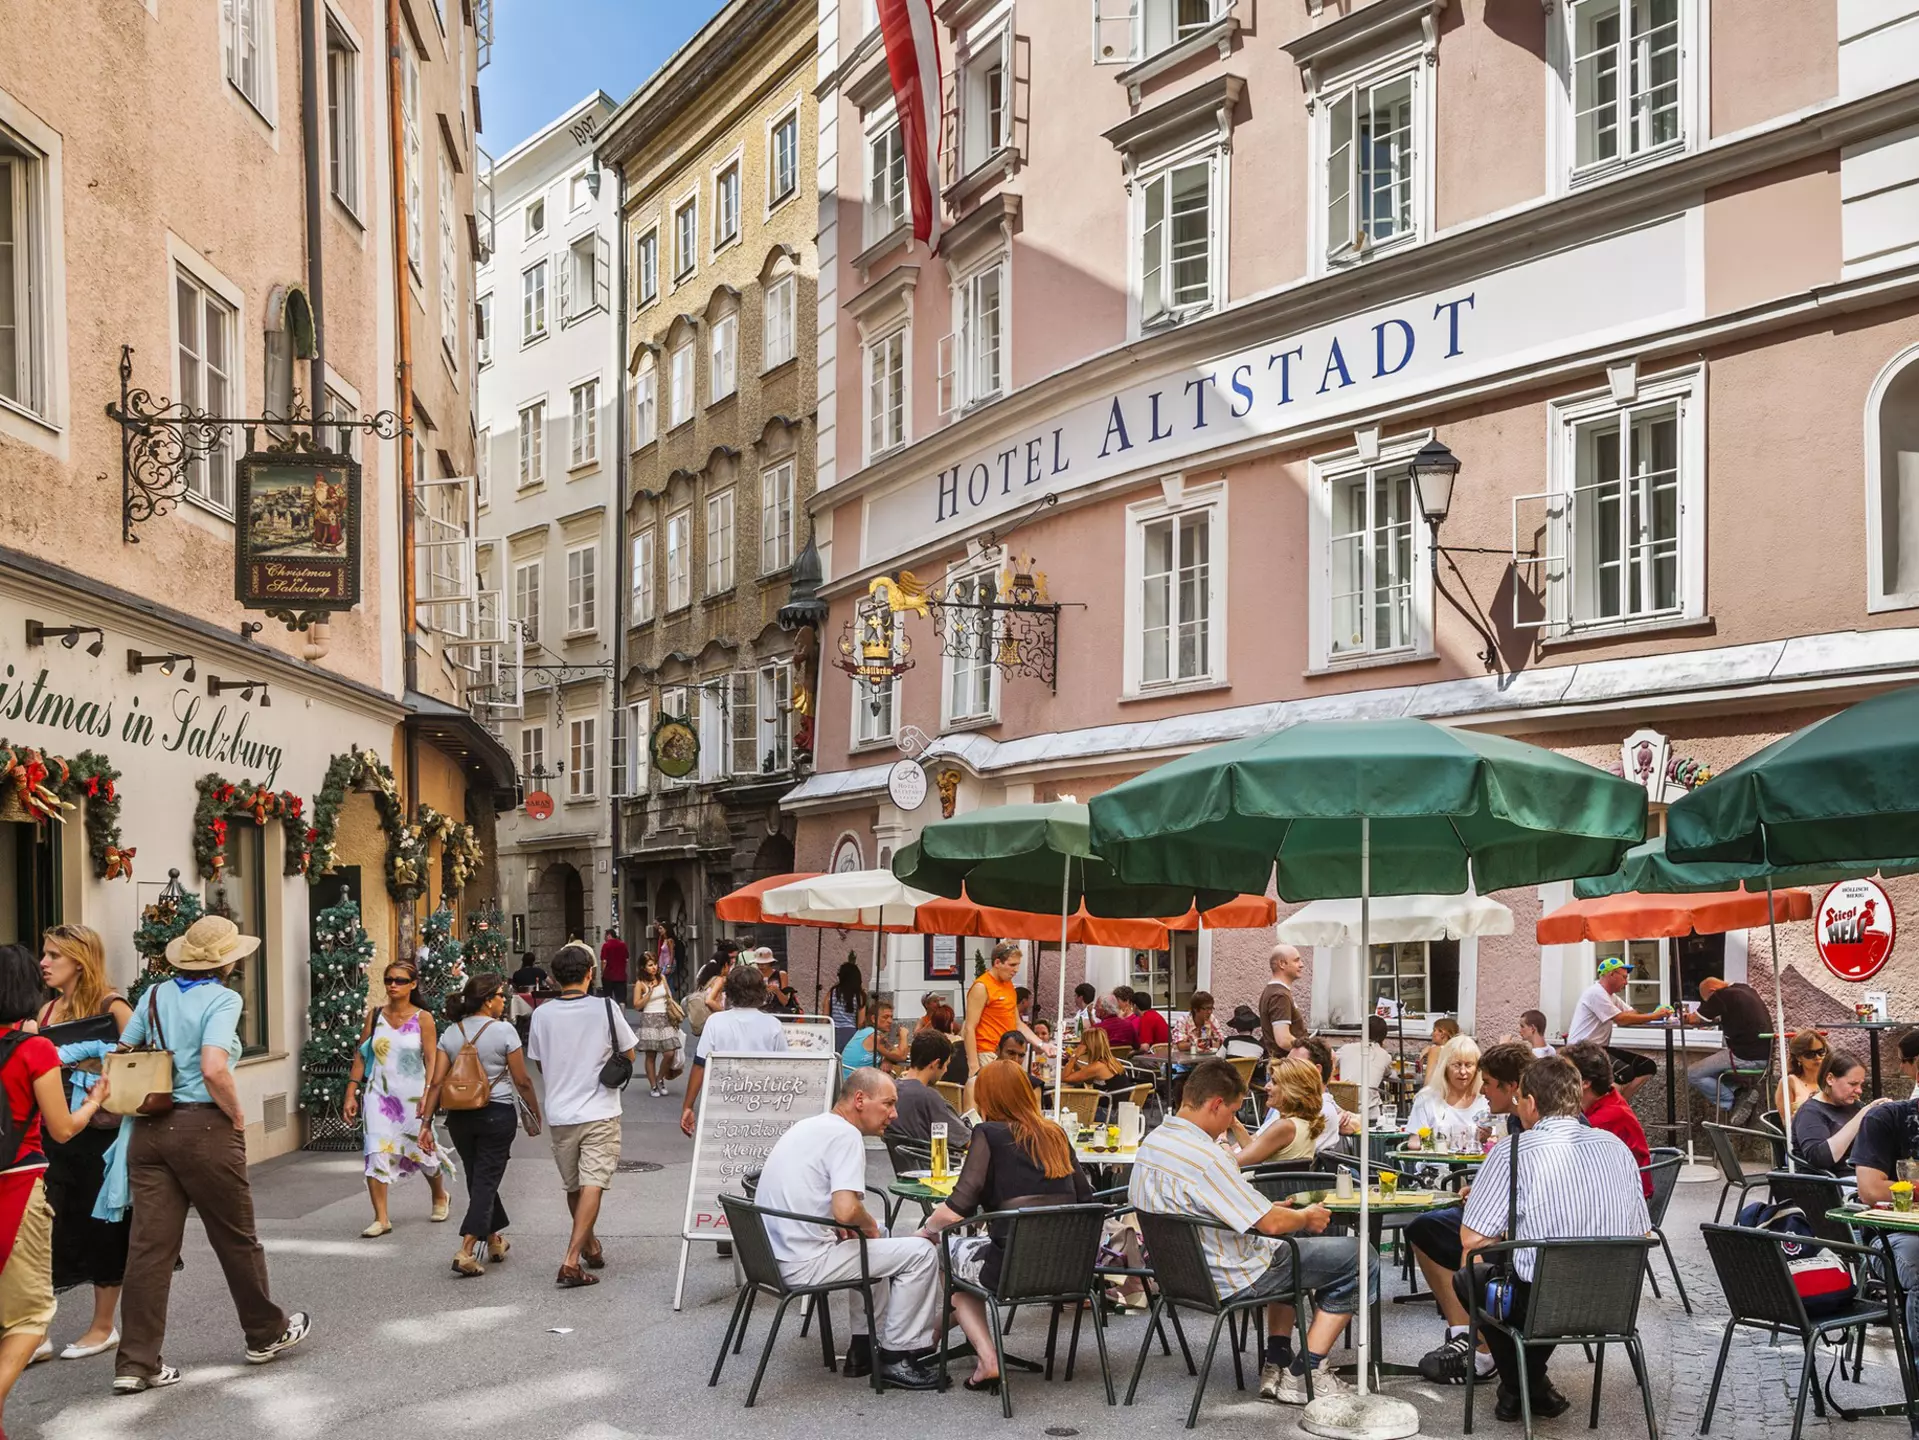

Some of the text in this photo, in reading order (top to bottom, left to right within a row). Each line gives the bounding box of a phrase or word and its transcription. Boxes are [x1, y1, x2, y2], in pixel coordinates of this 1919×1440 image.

[569, 115, 597, 147] 1997
[935, 292, 1475, 523] HOTEL ALTSTADT
[265, 563, 332, 577] Christmas
[266, 580, 330, 597] Salzburg
[122, 696, 154, 746] in
[162, 688, 282, 790] Salzburg
[1826, 906, 1857, 928] Stiegl
[1828, 919, 1866, 944] HELL
[723, 1094, 744, 1104] von
